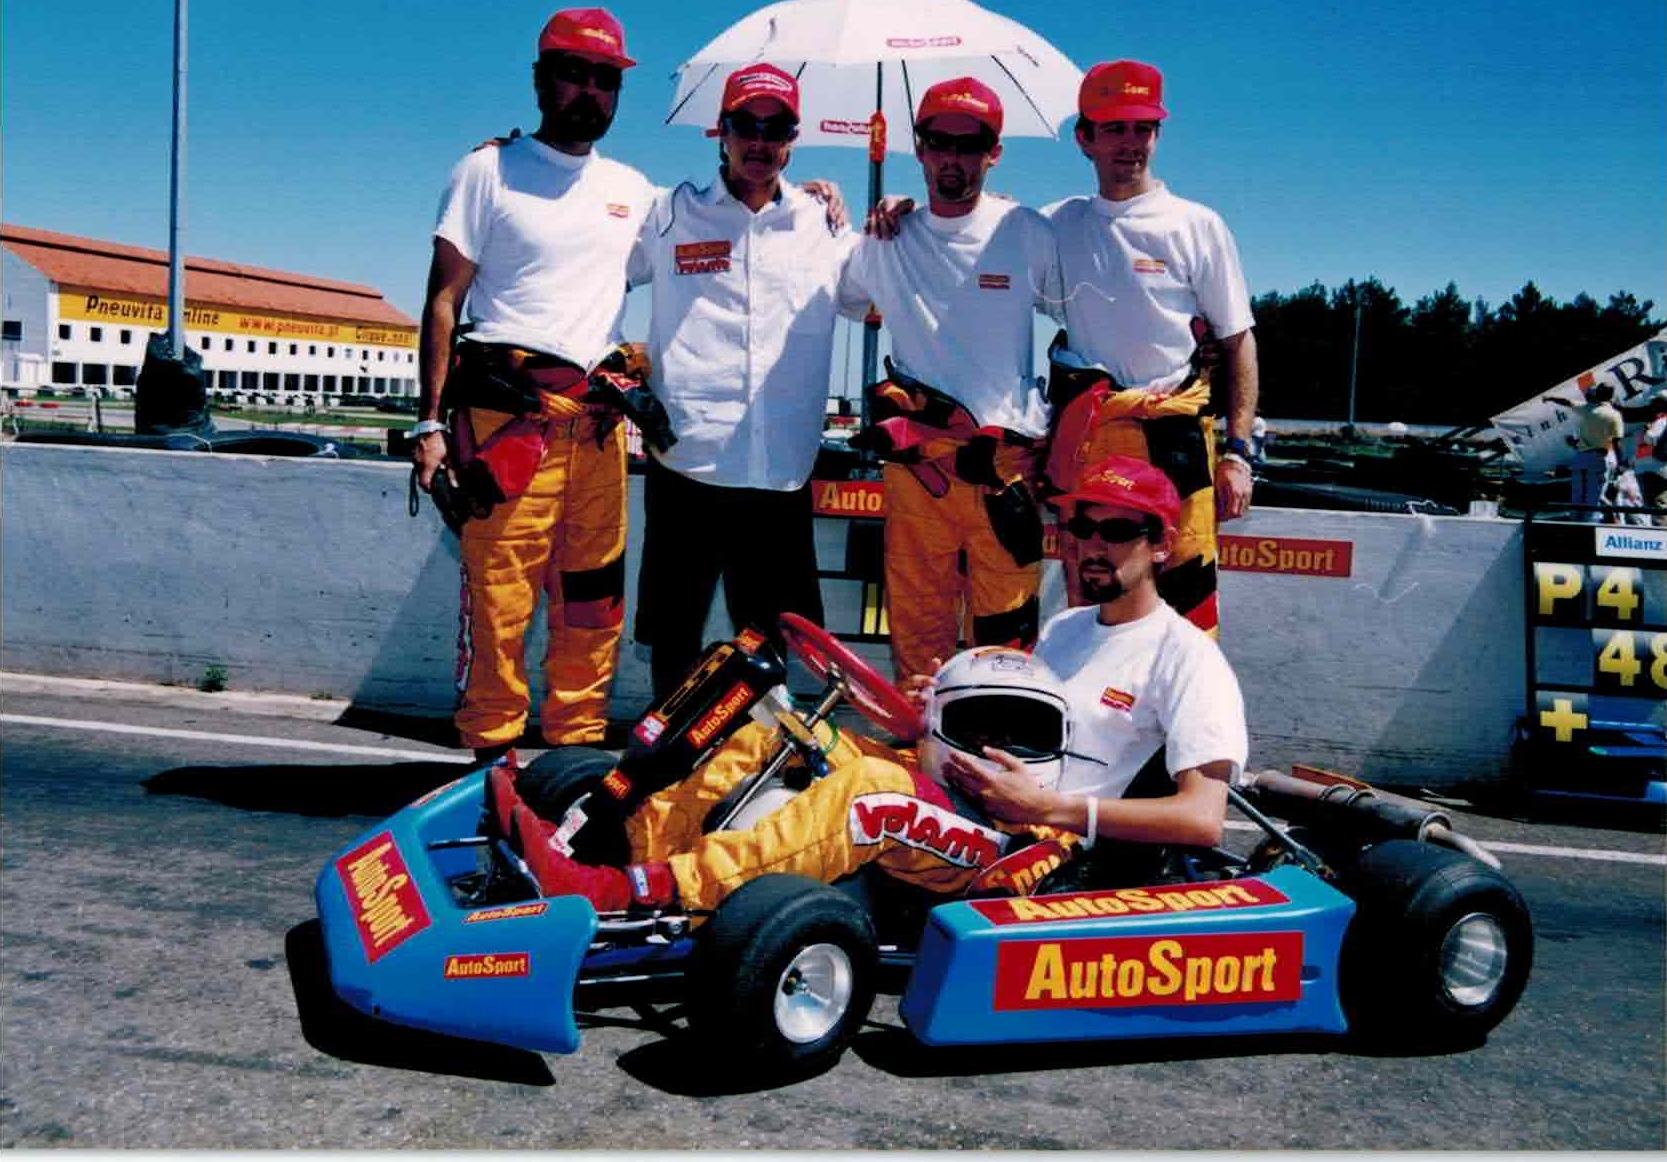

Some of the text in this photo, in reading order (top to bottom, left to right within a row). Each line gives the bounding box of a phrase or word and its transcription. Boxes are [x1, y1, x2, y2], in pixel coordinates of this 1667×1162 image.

[86, 294, 220, 326] Pneuvita nline
[1217, 539, 1335, 571] utoSport
[1604, 535, 1663, 550] Allianz
[347, 841, 415, 948] AutoSport
[1007, 883, 1260, 921] AutoSport
[447, 955, 526, 975] AutoSport
[1024, 938, 1277, 1001] AutoSport
